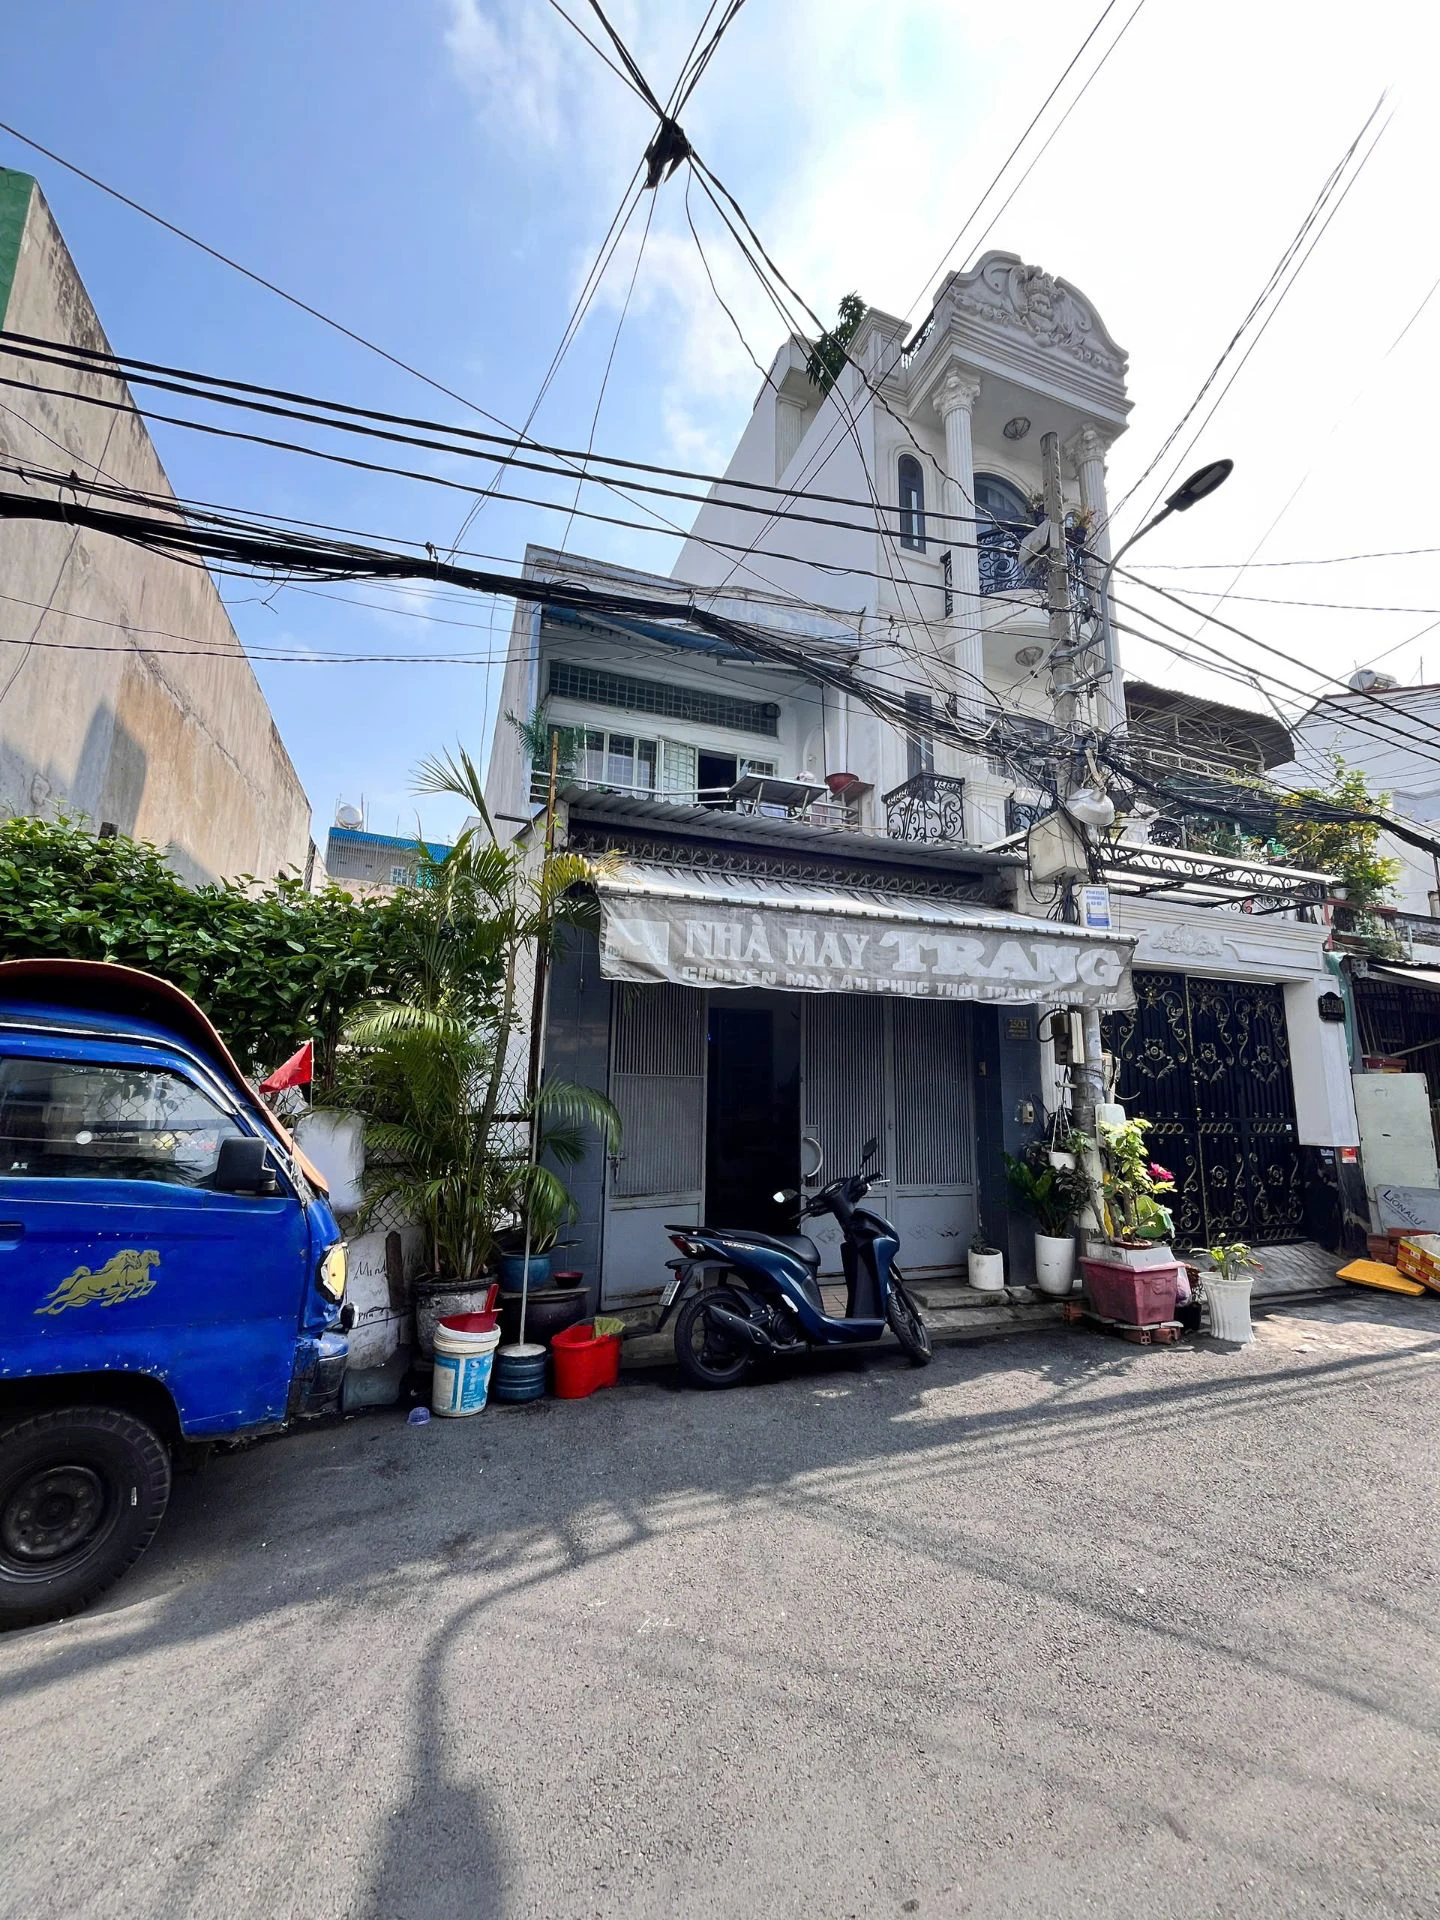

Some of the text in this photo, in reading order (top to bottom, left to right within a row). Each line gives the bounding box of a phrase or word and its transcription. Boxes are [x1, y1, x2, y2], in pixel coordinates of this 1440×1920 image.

[683, 914, 1125, 986] NHÀ MAY TRANG
[682, 966, 777, 985] CHUYÊN
[785, 973, 832, 990] MAY
[984, 985, 1043, 1002] TRANG
[1049, 990, 1084, 1004] NAM
